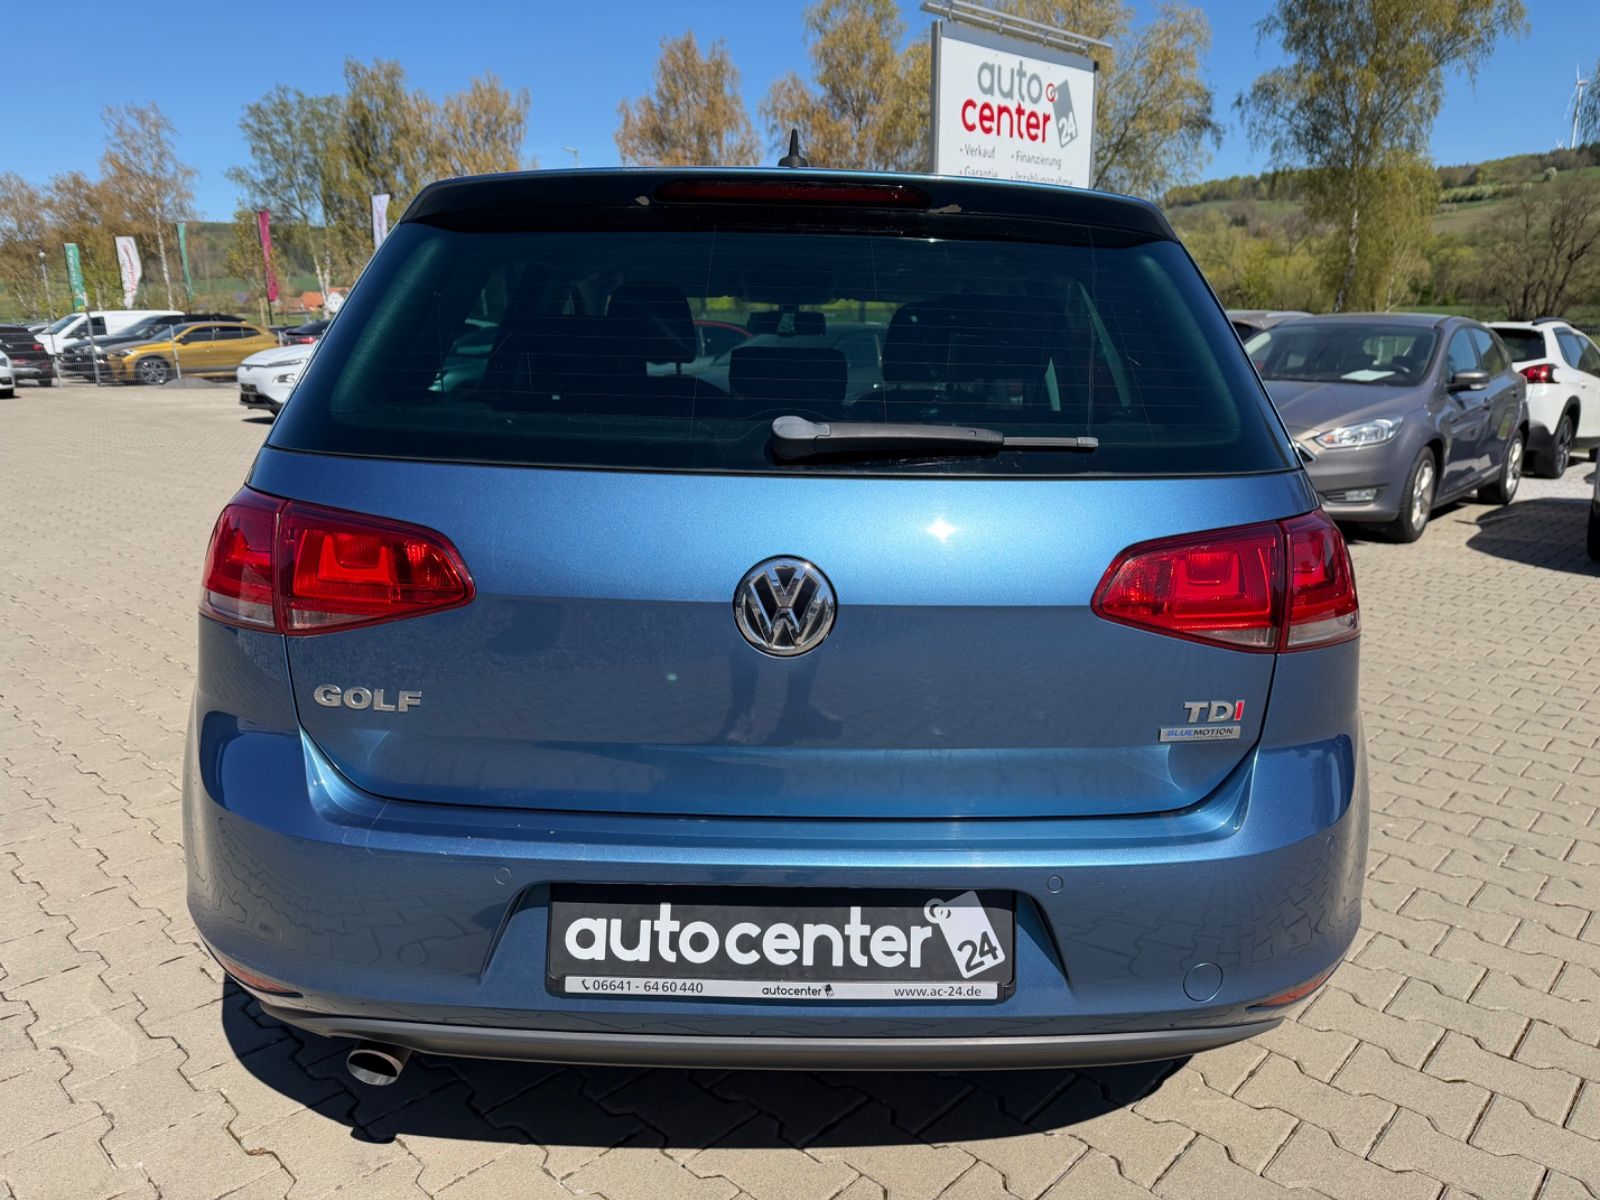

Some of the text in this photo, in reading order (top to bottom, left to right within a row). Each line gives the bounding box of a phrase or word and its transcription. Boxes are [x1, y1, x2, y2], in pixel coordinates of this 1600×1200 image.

[977, 60, 1042, 104] auto
[961, 98, 1051, 143] center
[1058, 111, 1076, 142] 24
[964, 144, 996, 159] Verkauf
[1015, 150, 1062, 170] Finanzierung
[314, 684, 422, 712] GOLF
[1184, 700, 1245, 723] TDI
[565, 902, 932, 968] autocenter
[956, 931, 1000, 973] 24
[592, 979, 631, 992] 06641
[762, 984, 822, 996] autocenter
[894, 986, 982, 997] www.ac-24.de
